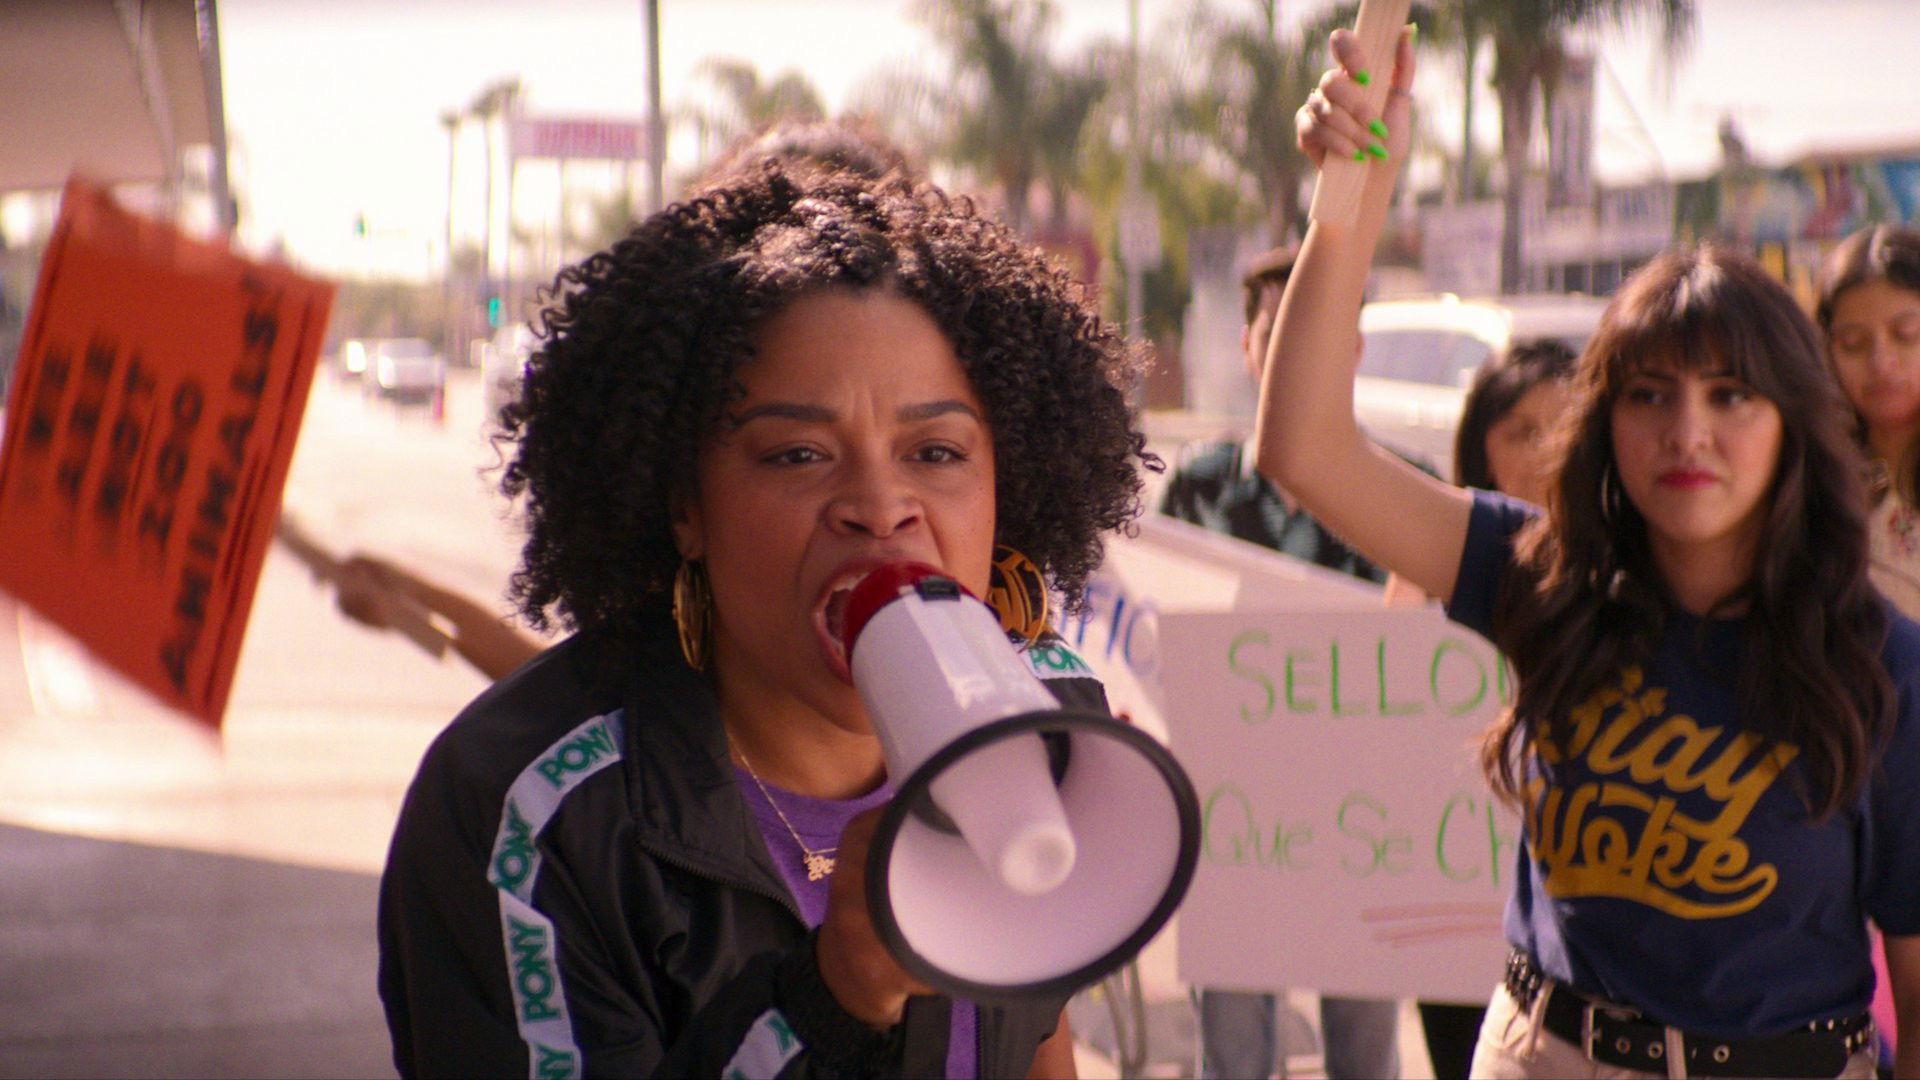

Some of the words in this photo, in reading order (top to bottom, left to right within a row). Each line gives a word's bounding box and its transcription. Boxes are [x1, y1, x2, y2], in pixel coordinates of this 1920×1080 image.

[537, 722, 617, 789] PONY
[1200, 782, 1314, 870] Que
[1336, 793, 1414, 878] Se
[508, 913, 560, 1022] PONY
